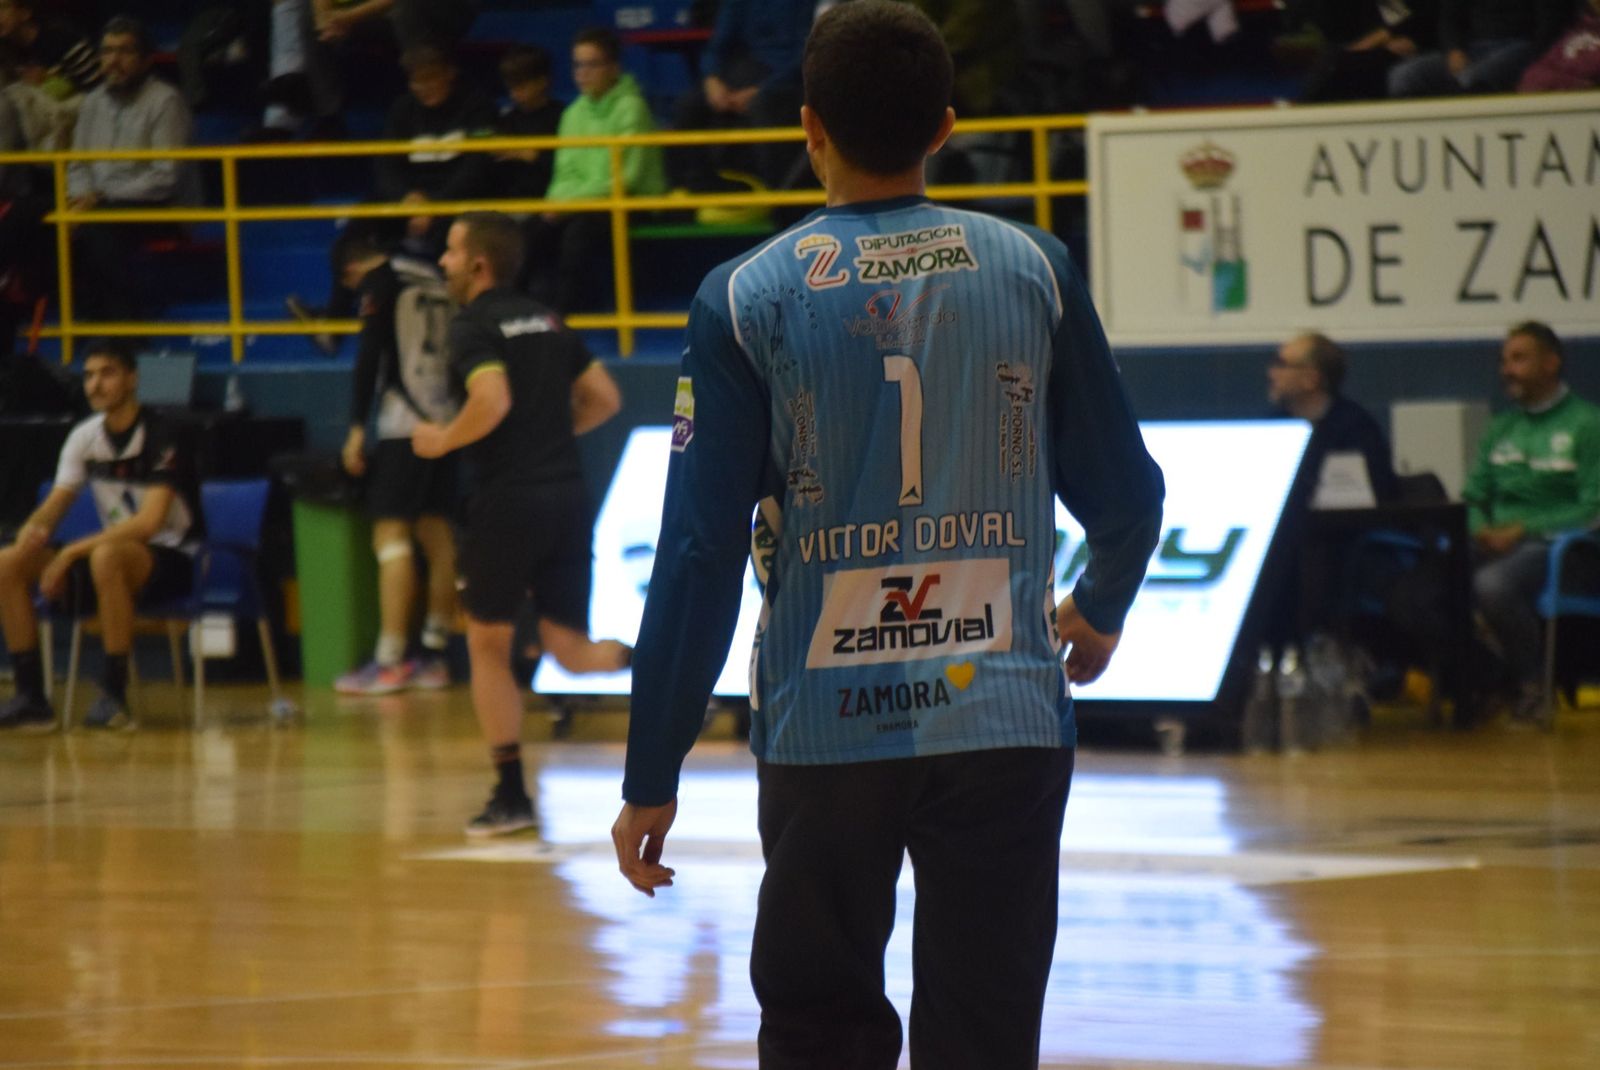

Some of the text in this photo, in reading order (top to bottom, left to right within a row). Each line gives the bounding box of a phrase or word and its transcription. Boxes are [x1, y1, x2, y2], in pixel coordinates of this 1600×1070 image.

[857, 246, 976, 281] ZAMORA
[1304, 223, 1404, 308] DE
[882, 354, 924, 506] 1
[1011, 404, 1024, 455] PIORNO
[798, 518, 900, 565] VICTOR
[913, 511, 1027, 551] DOVAL
[832, 603, 995, 655] zamovial
[838, 678, 952, 719] ZAMORA
